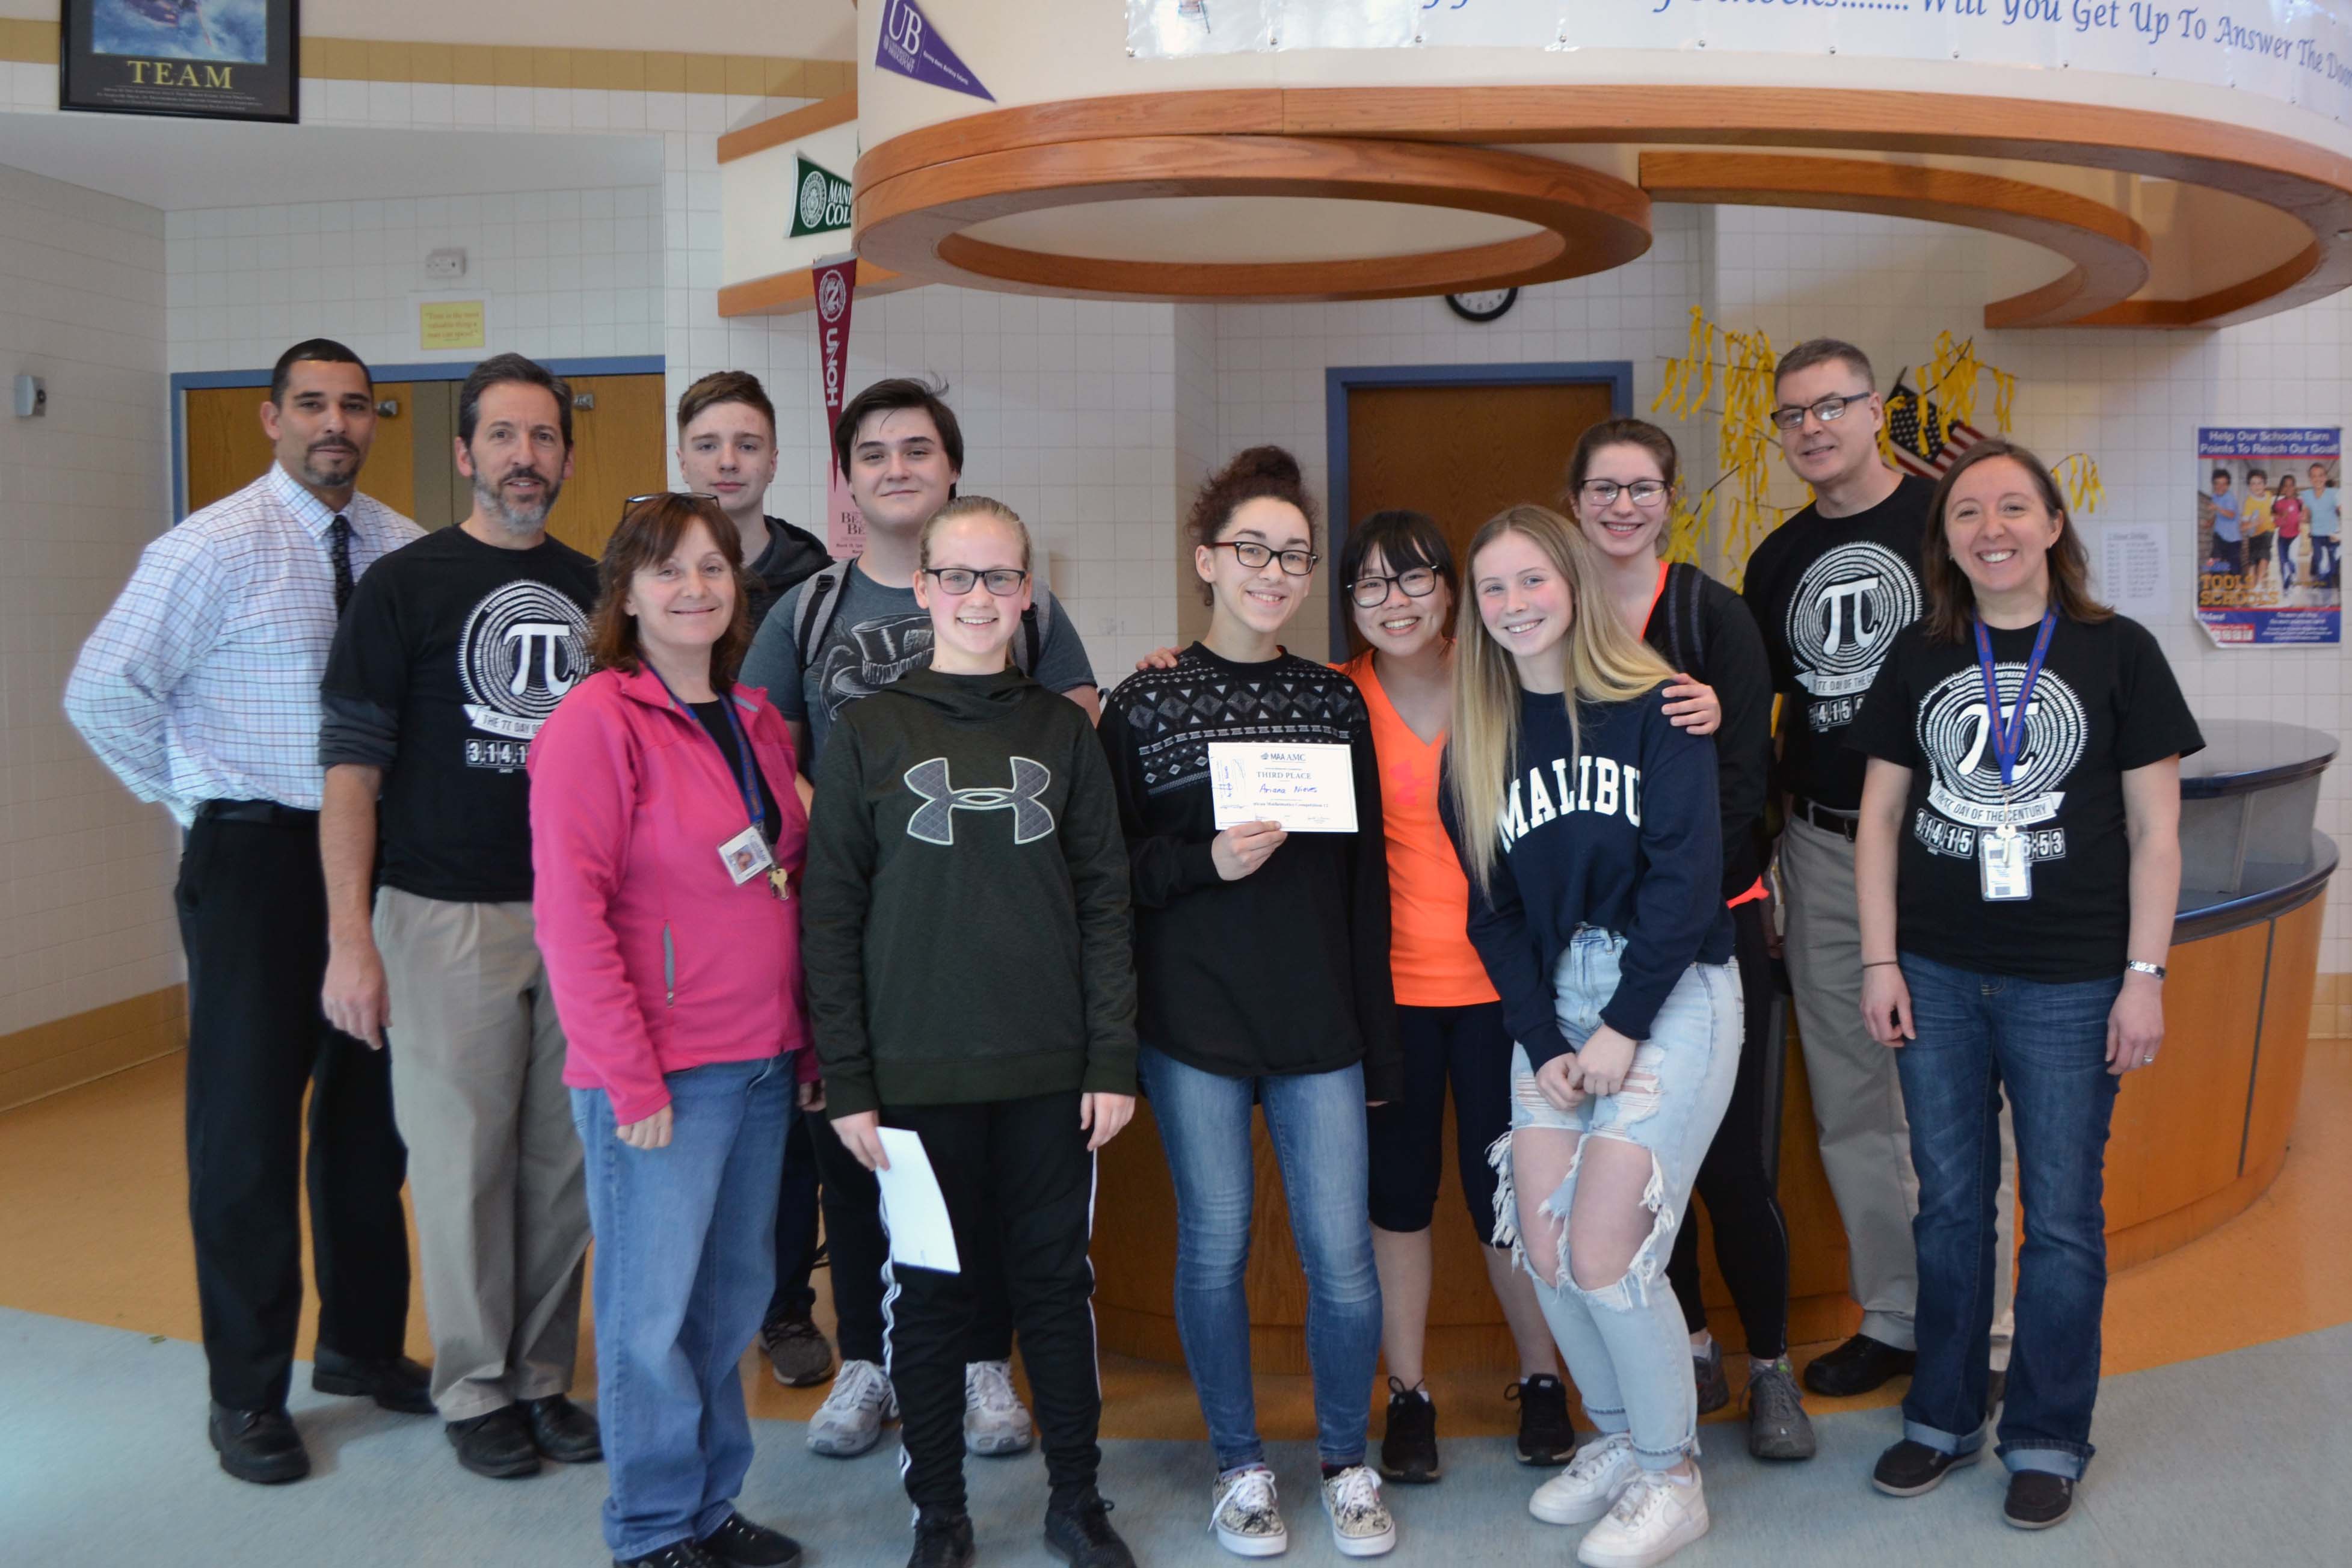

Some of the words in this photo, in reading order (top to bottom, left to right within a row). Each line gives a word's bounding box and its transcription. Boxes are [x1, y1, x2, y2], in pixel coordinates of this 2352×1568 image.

[888, 0, 922, 55] UB
[2003, 0, 2062, 25] You
[2072, 0, 2120, 32] Get
[2129, 1, 2169, 45] Up
[2177, 7, 2207, 39] To
[2214, 16, 2293, 60] Answer
[2297, 38, 2323, 73] The
[126, 60, 233, 89] TEAM
[828, 179, 852, 205] MAN
[825, 201, 851, 226] COL
[826, 327, 840, 407] UNOH
[2200, 443, 2235, 453] Points
[2237, 443, 2250, 453] To
[2252, 443, 2287, 453] Reach
[2289, 443, 2309, 453] Our
[2209, 431, 2235, 443] Help
[2237, 431, 2256, 441] Our
[2259, 430, 2303, 441] Schools
[2305, 431, 2330, 441] Earn
[2200, 574, 2255, 589] TOOLS
[2200, 591, 2279, 606] SCHOOLS
[1497, 755, 1641, 854] MALIBU
[1953, 803, 1971, 819] DAY
[1971, 808, 1984, 820] OF
[1986, 810, 2004, 822] THE
[2007, 802, 2046, 822] CENTURY
